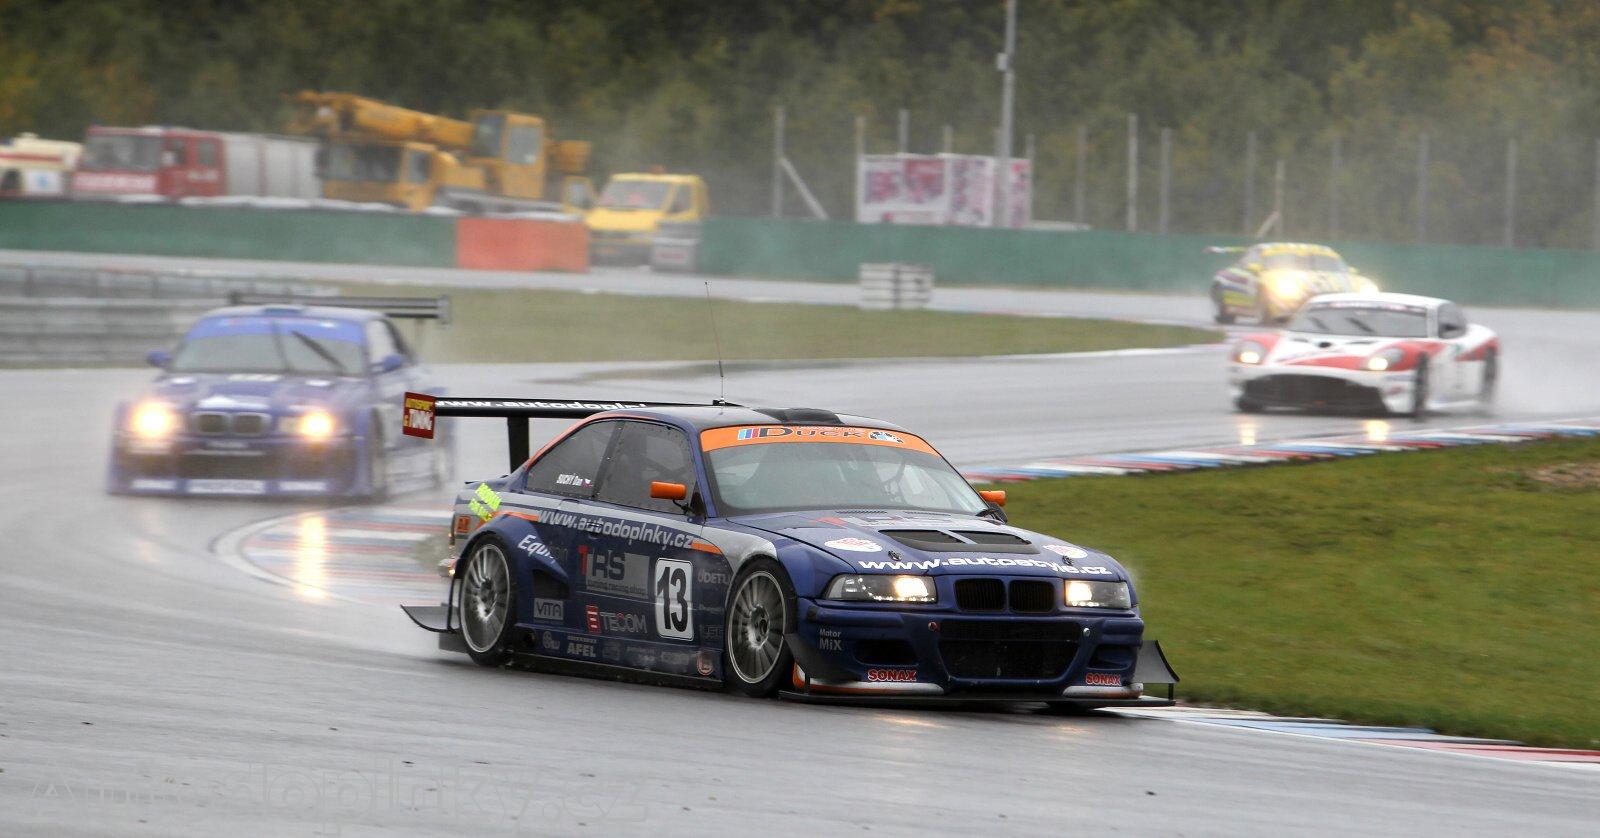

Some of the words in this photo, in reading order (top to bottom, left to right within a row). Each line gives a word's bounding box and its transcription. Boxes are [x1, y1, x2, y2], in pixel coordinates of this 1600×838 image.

[538, 509, 694, 550] www.autodoplnky.cz
[858, 557, 1113, 575] www.autostyle.cz
[656, 566, 689, 633] 13
[819, 628, 842, 638] Motor
[567, 642, 597, 658] AFEL
[867, 669, 918, 682] SONAX
[1085, 672, 1121, 686] SONAX
